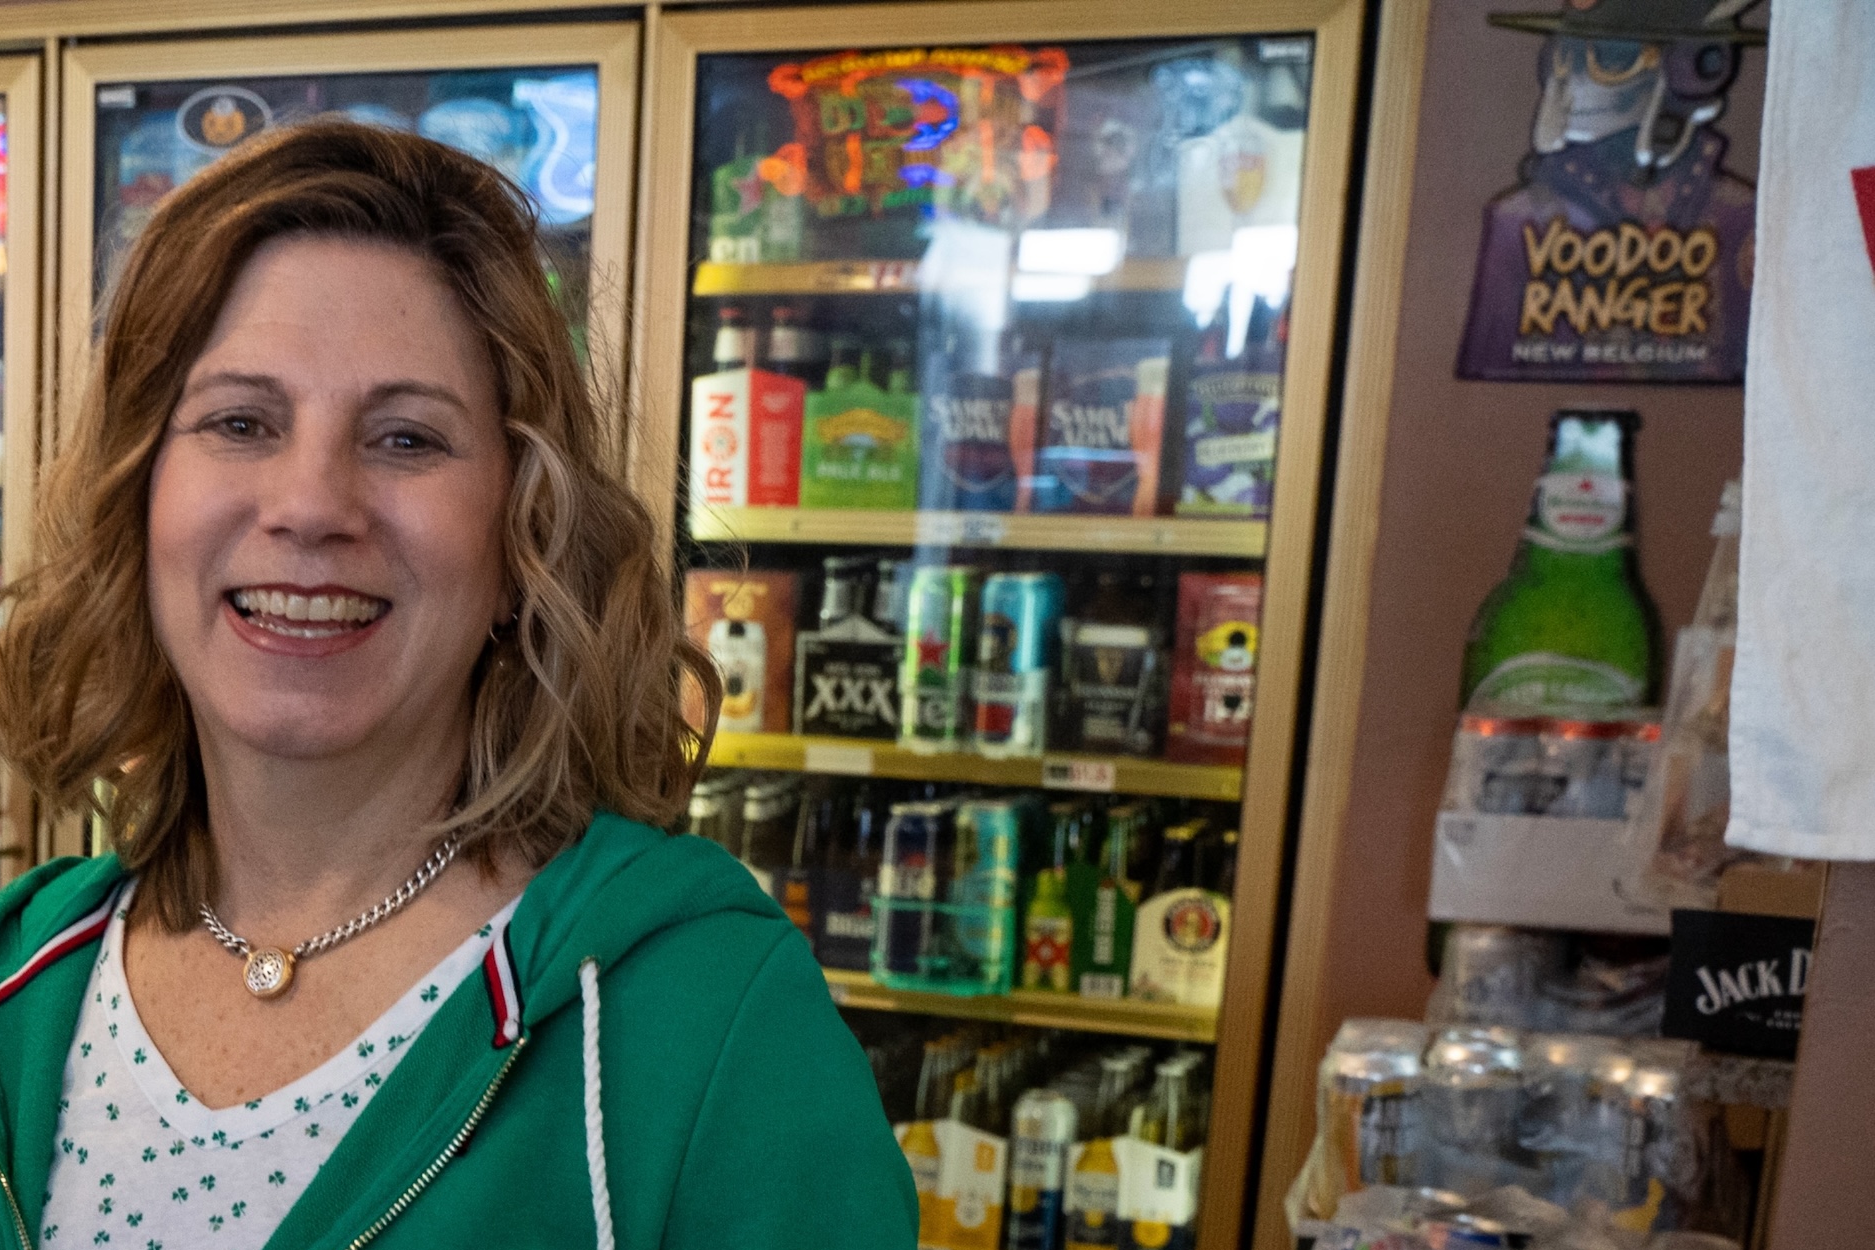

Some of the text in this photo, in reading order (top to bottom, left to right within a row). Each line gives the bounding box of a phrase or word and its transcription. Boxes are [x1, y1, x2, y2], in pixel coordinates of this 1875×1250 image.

[1525, 216, 1719, 278] VOODOO
[1519, 277, 1710, 337] RANGER
[1512, 343, 1708, 364] NEW BELGIUM
[815, 458, 903, 484] PALE ALE
[1695, 959, 1783, 1016] JACK
